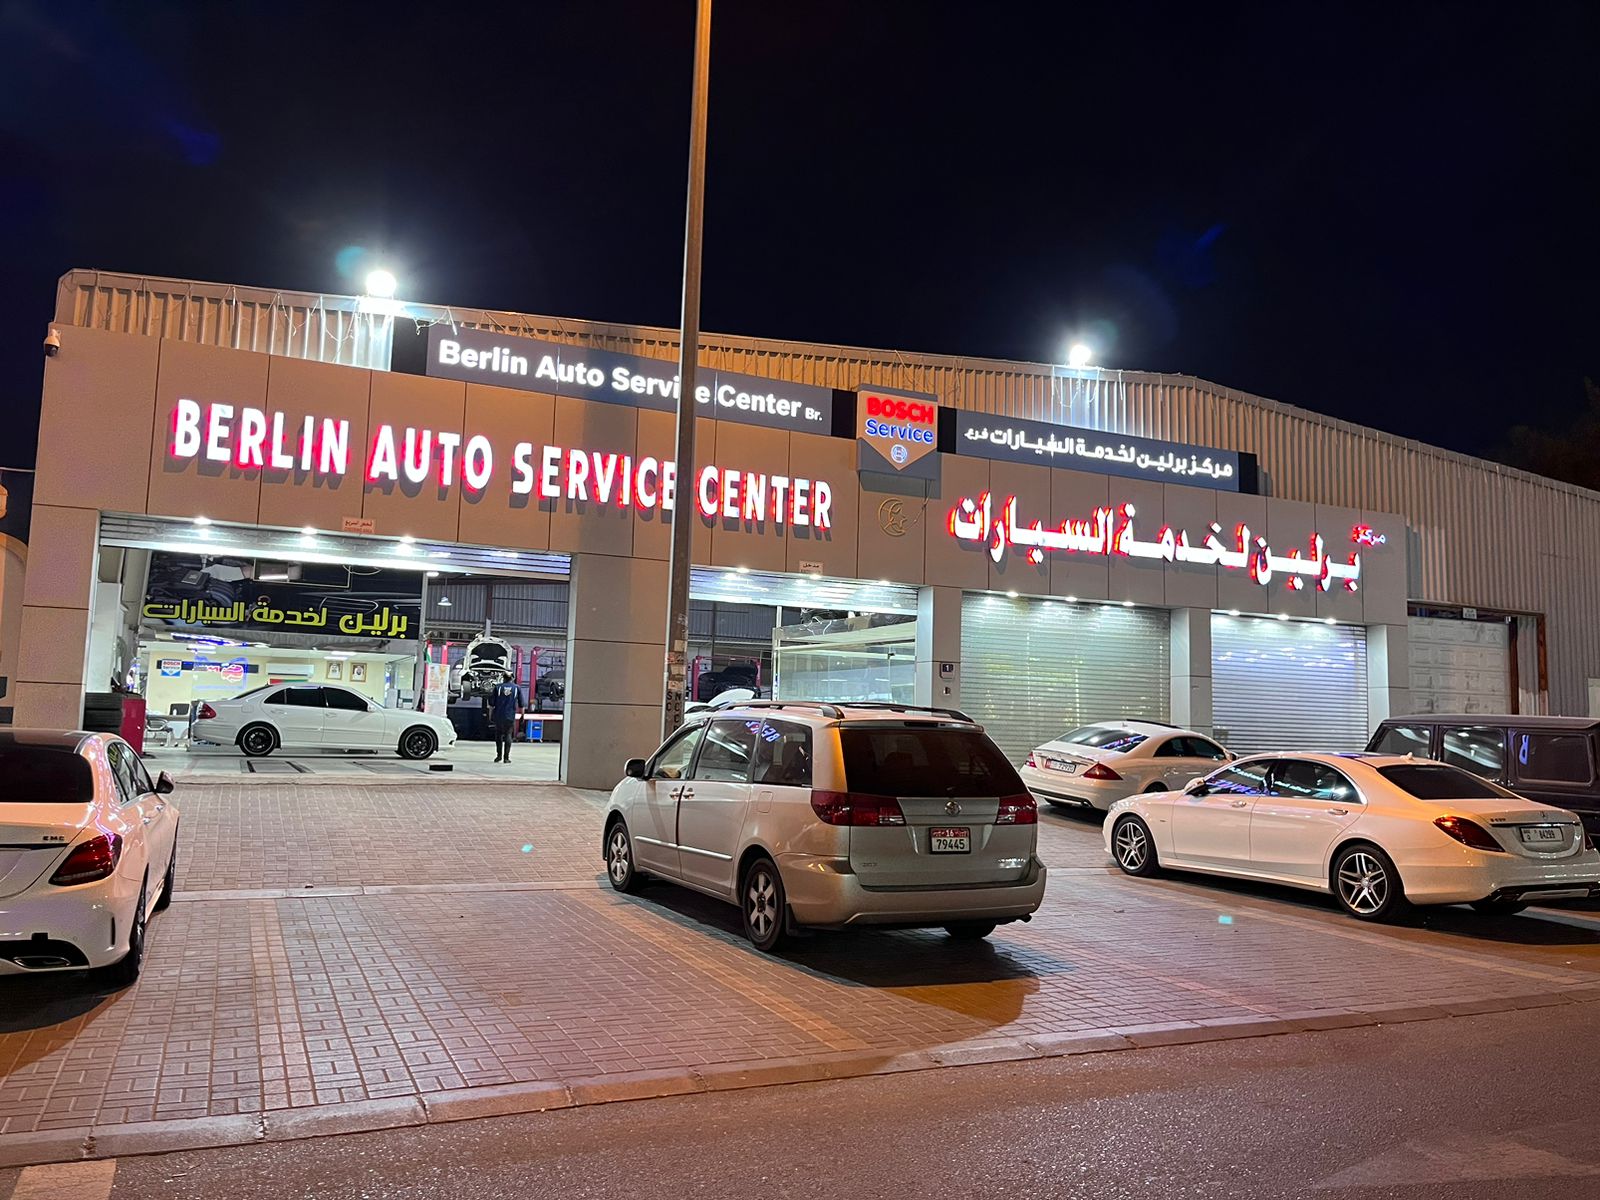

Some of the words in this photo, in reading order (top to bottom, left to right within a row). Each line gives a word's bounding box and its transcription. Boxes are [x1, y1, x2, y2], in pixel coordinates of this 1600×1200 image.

[438, 339, 528, 376] Berlin
[535, 355, 605, 387] Auto
[611, 366, 710, 404] Servie
[717, 384, 802, 417] Center
[805, 407, 823, 421] Br.
[866, 396, 935, 425] BOSCH
[865, 418, 935, 444] Service
[990, 427, 1075, 456] السيارات
[173, 398, 350, 476] BERLIN
[368, 424, 494, 490] AUTO
[511, 442, 676, 511] SERVICE
[697, 464, 833, 529] CENTER
[1076, 437, 1135, 464] لخدمة
[1136, 449, 1188, 475] برلين
[1188, 454, 1233, 478] مركز
[951, 490, 1115, 565] السيارات
[1115, 503, 1251, 568] لخدمة
[1251, 532, 1361, 593] برلين
[142, 598, 246, 626] السيارات
[252, 600, 328, 627] لخدمة
[338, 606, 408, 640] برلين
[936, 838, 966, 850] 79445
